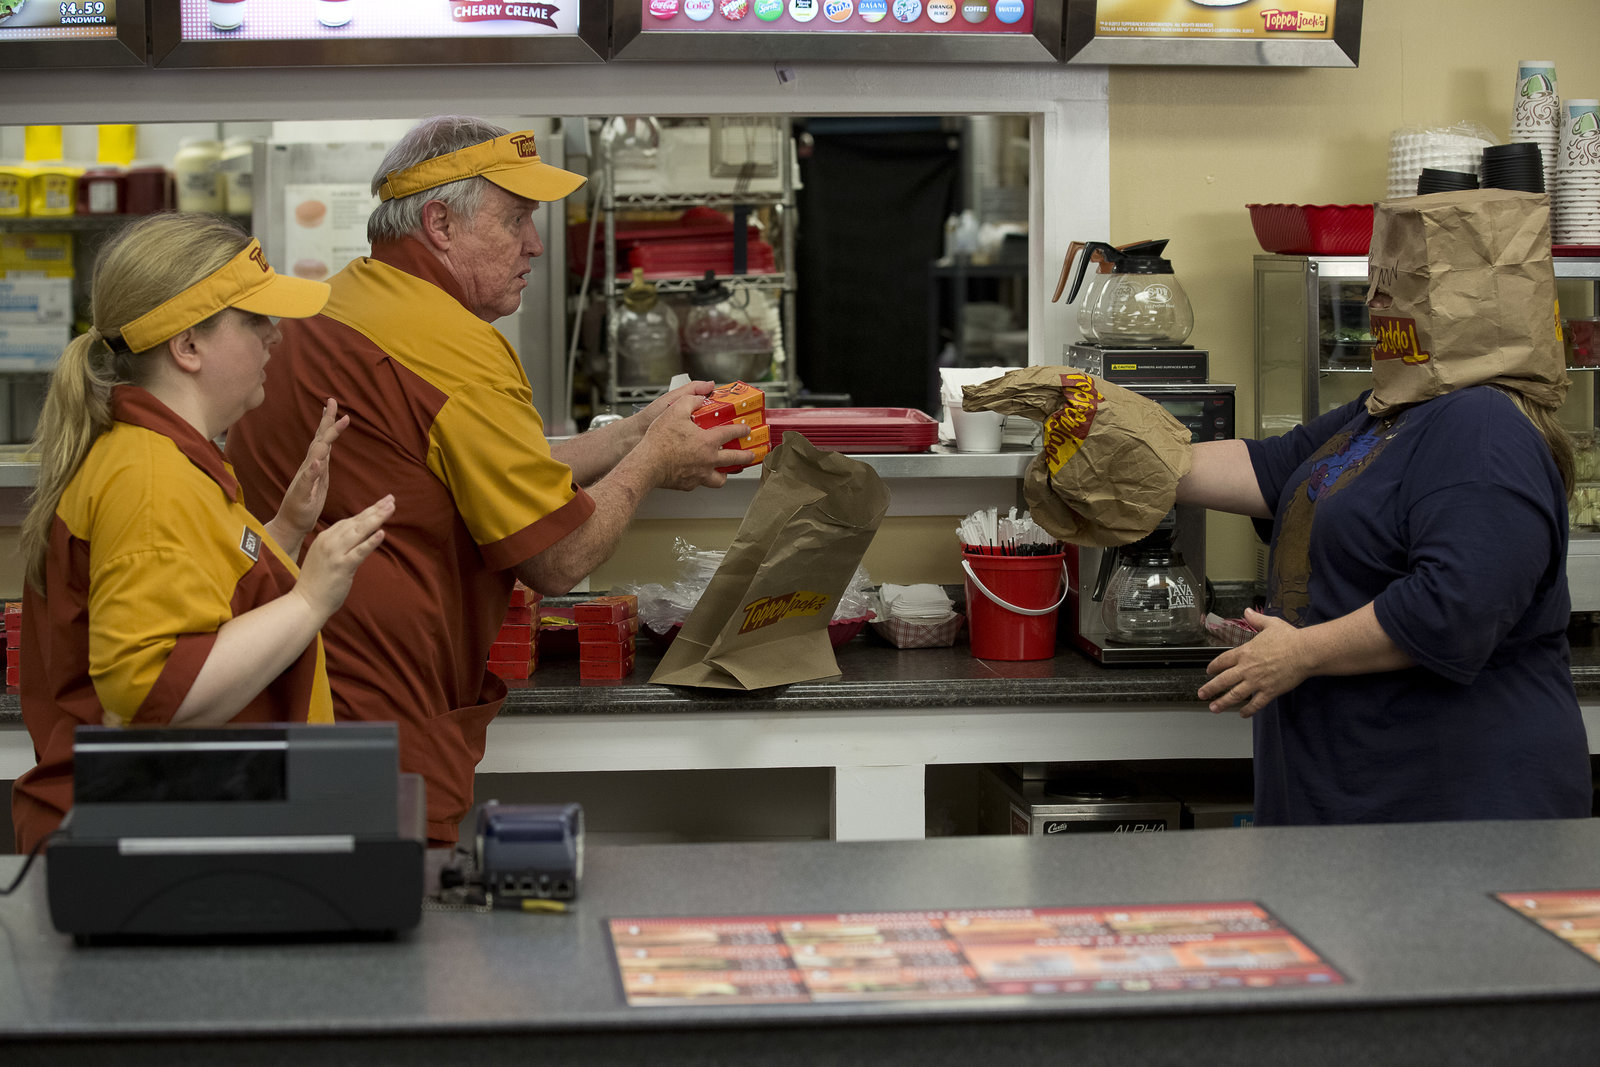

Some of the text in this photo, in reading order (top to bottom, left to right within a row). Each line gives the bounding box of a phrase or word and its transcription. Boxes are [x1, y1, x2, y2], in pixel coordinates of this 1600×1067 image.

[60, 2, 105, 15] $4.59
[453, 5, 548, 19] CHERRY CREME
[686, 1, 710, 10] Coke
[826, 2, 850, 16] Fanta
[61, 16, 106, 24] SANDWICH
[1167, 583, 1194, 600] JAVA
[1168, 596, 1194, 607] LANE
